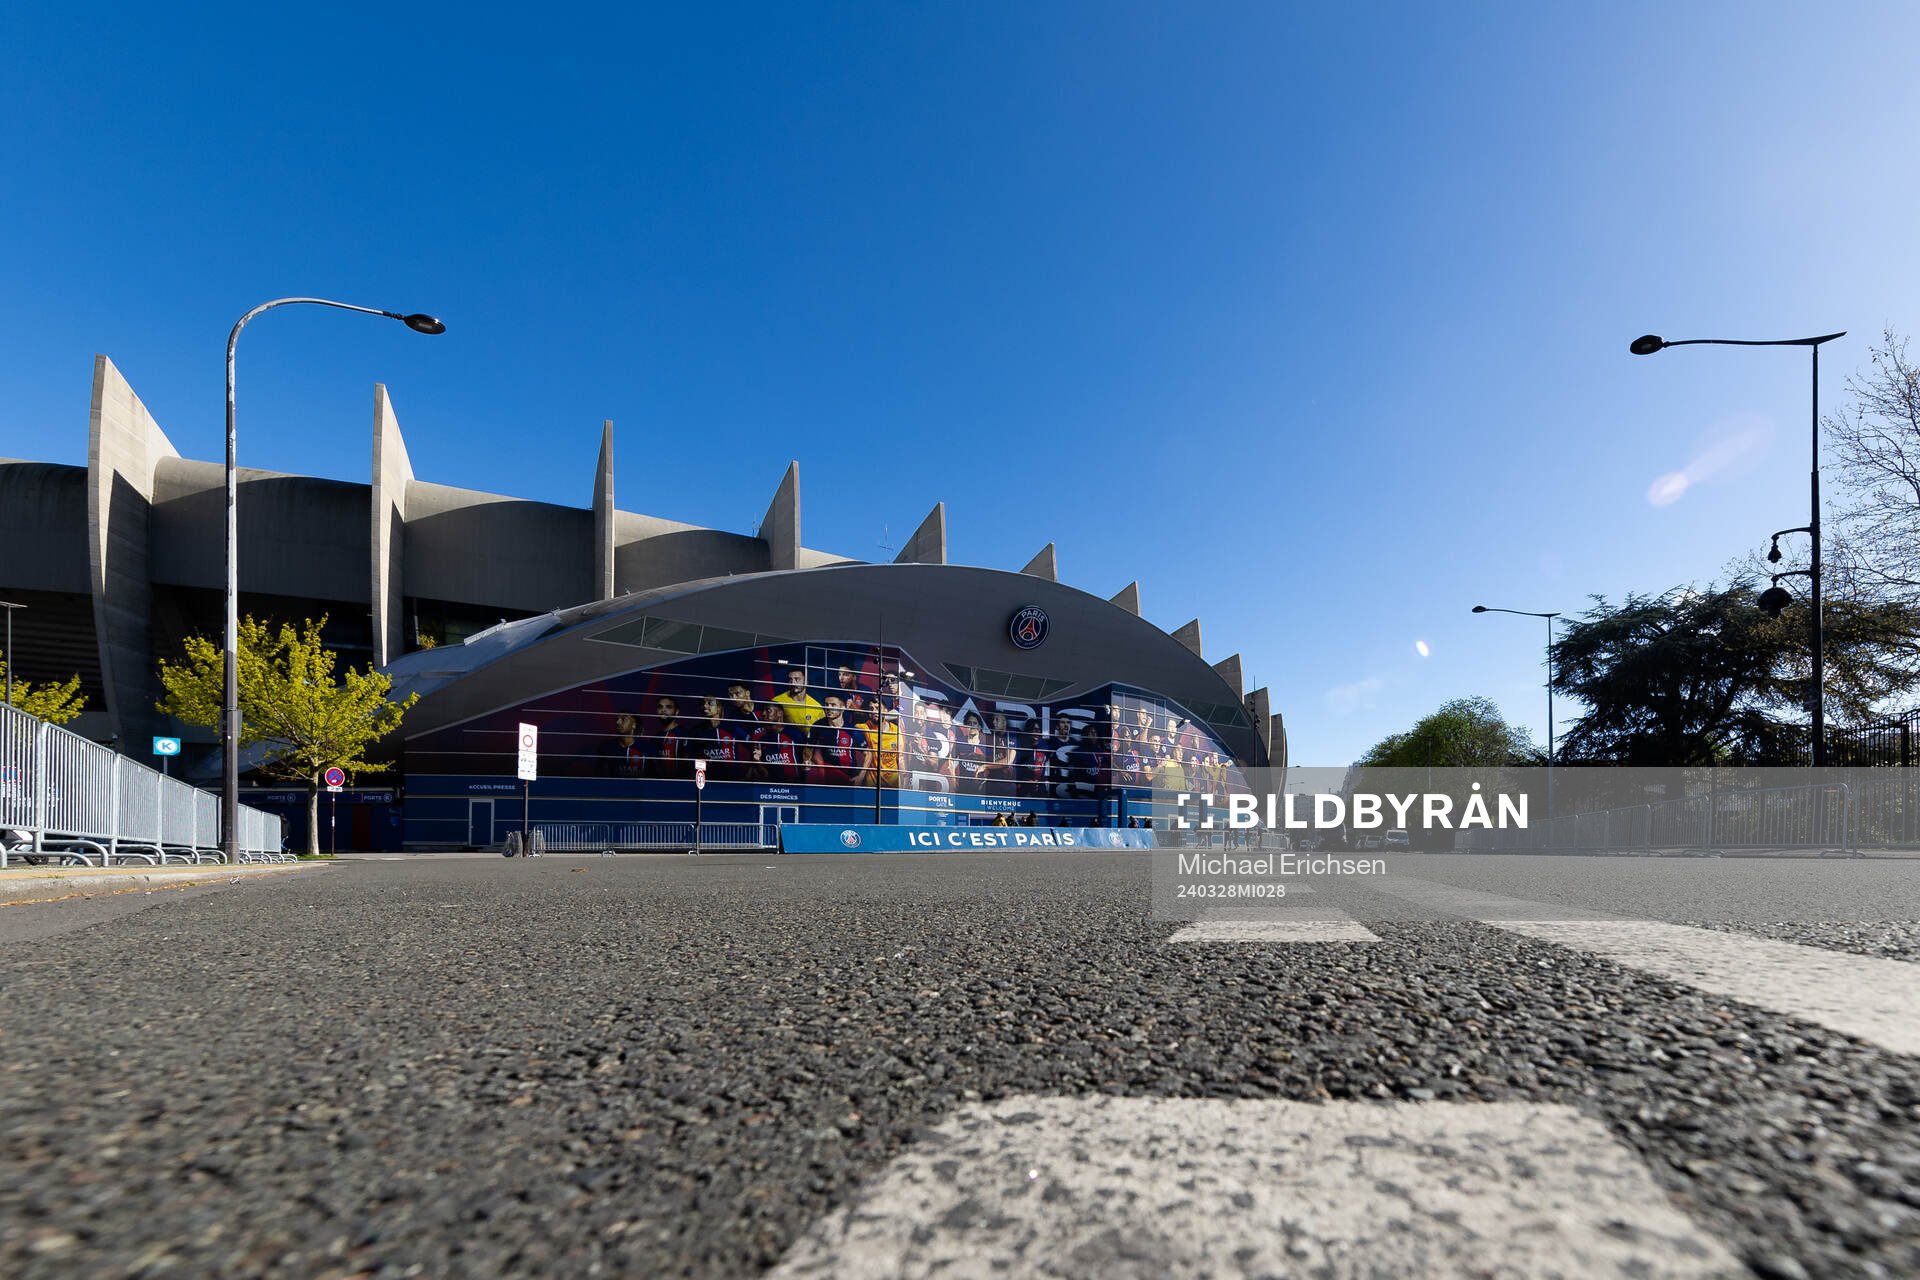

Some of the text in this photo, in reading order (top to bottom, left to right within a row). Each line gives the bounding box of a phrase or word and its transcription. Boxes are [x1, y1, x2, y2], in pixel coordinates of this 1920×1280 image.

[1021, 610, 1045, 623] PARIS
[765, 752, 789, 762] QATAR
[948, 798, 954, 807] L
[981, 799, 1021, 807] BIENVENUE
[909, 831, 1075, 847] ICI C'EST PARIS
